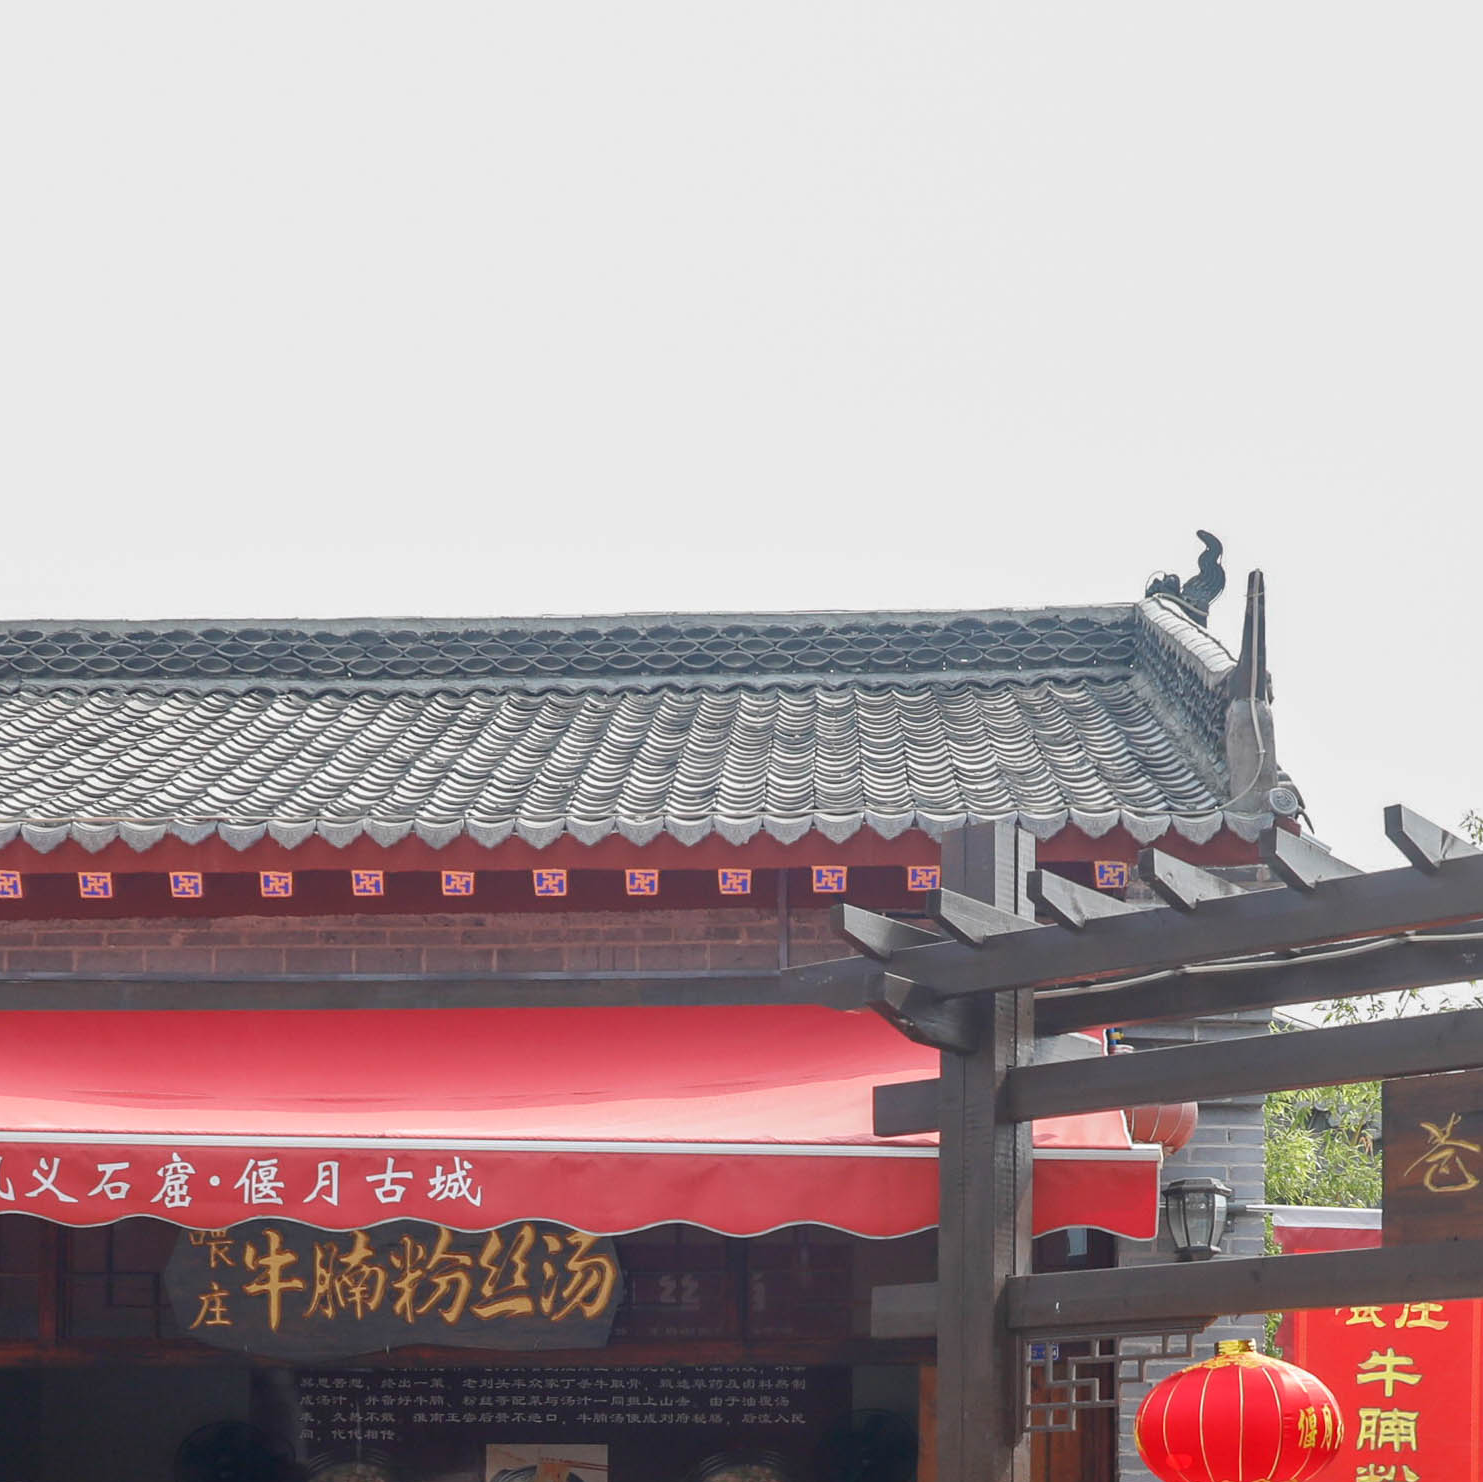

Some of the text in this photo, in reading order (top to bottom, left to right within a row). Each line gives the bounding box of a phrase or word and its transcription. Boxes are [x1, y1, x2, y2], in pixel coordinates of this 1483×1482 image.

[242, 1222, 617, 1332] 牛腩粉丝汤
